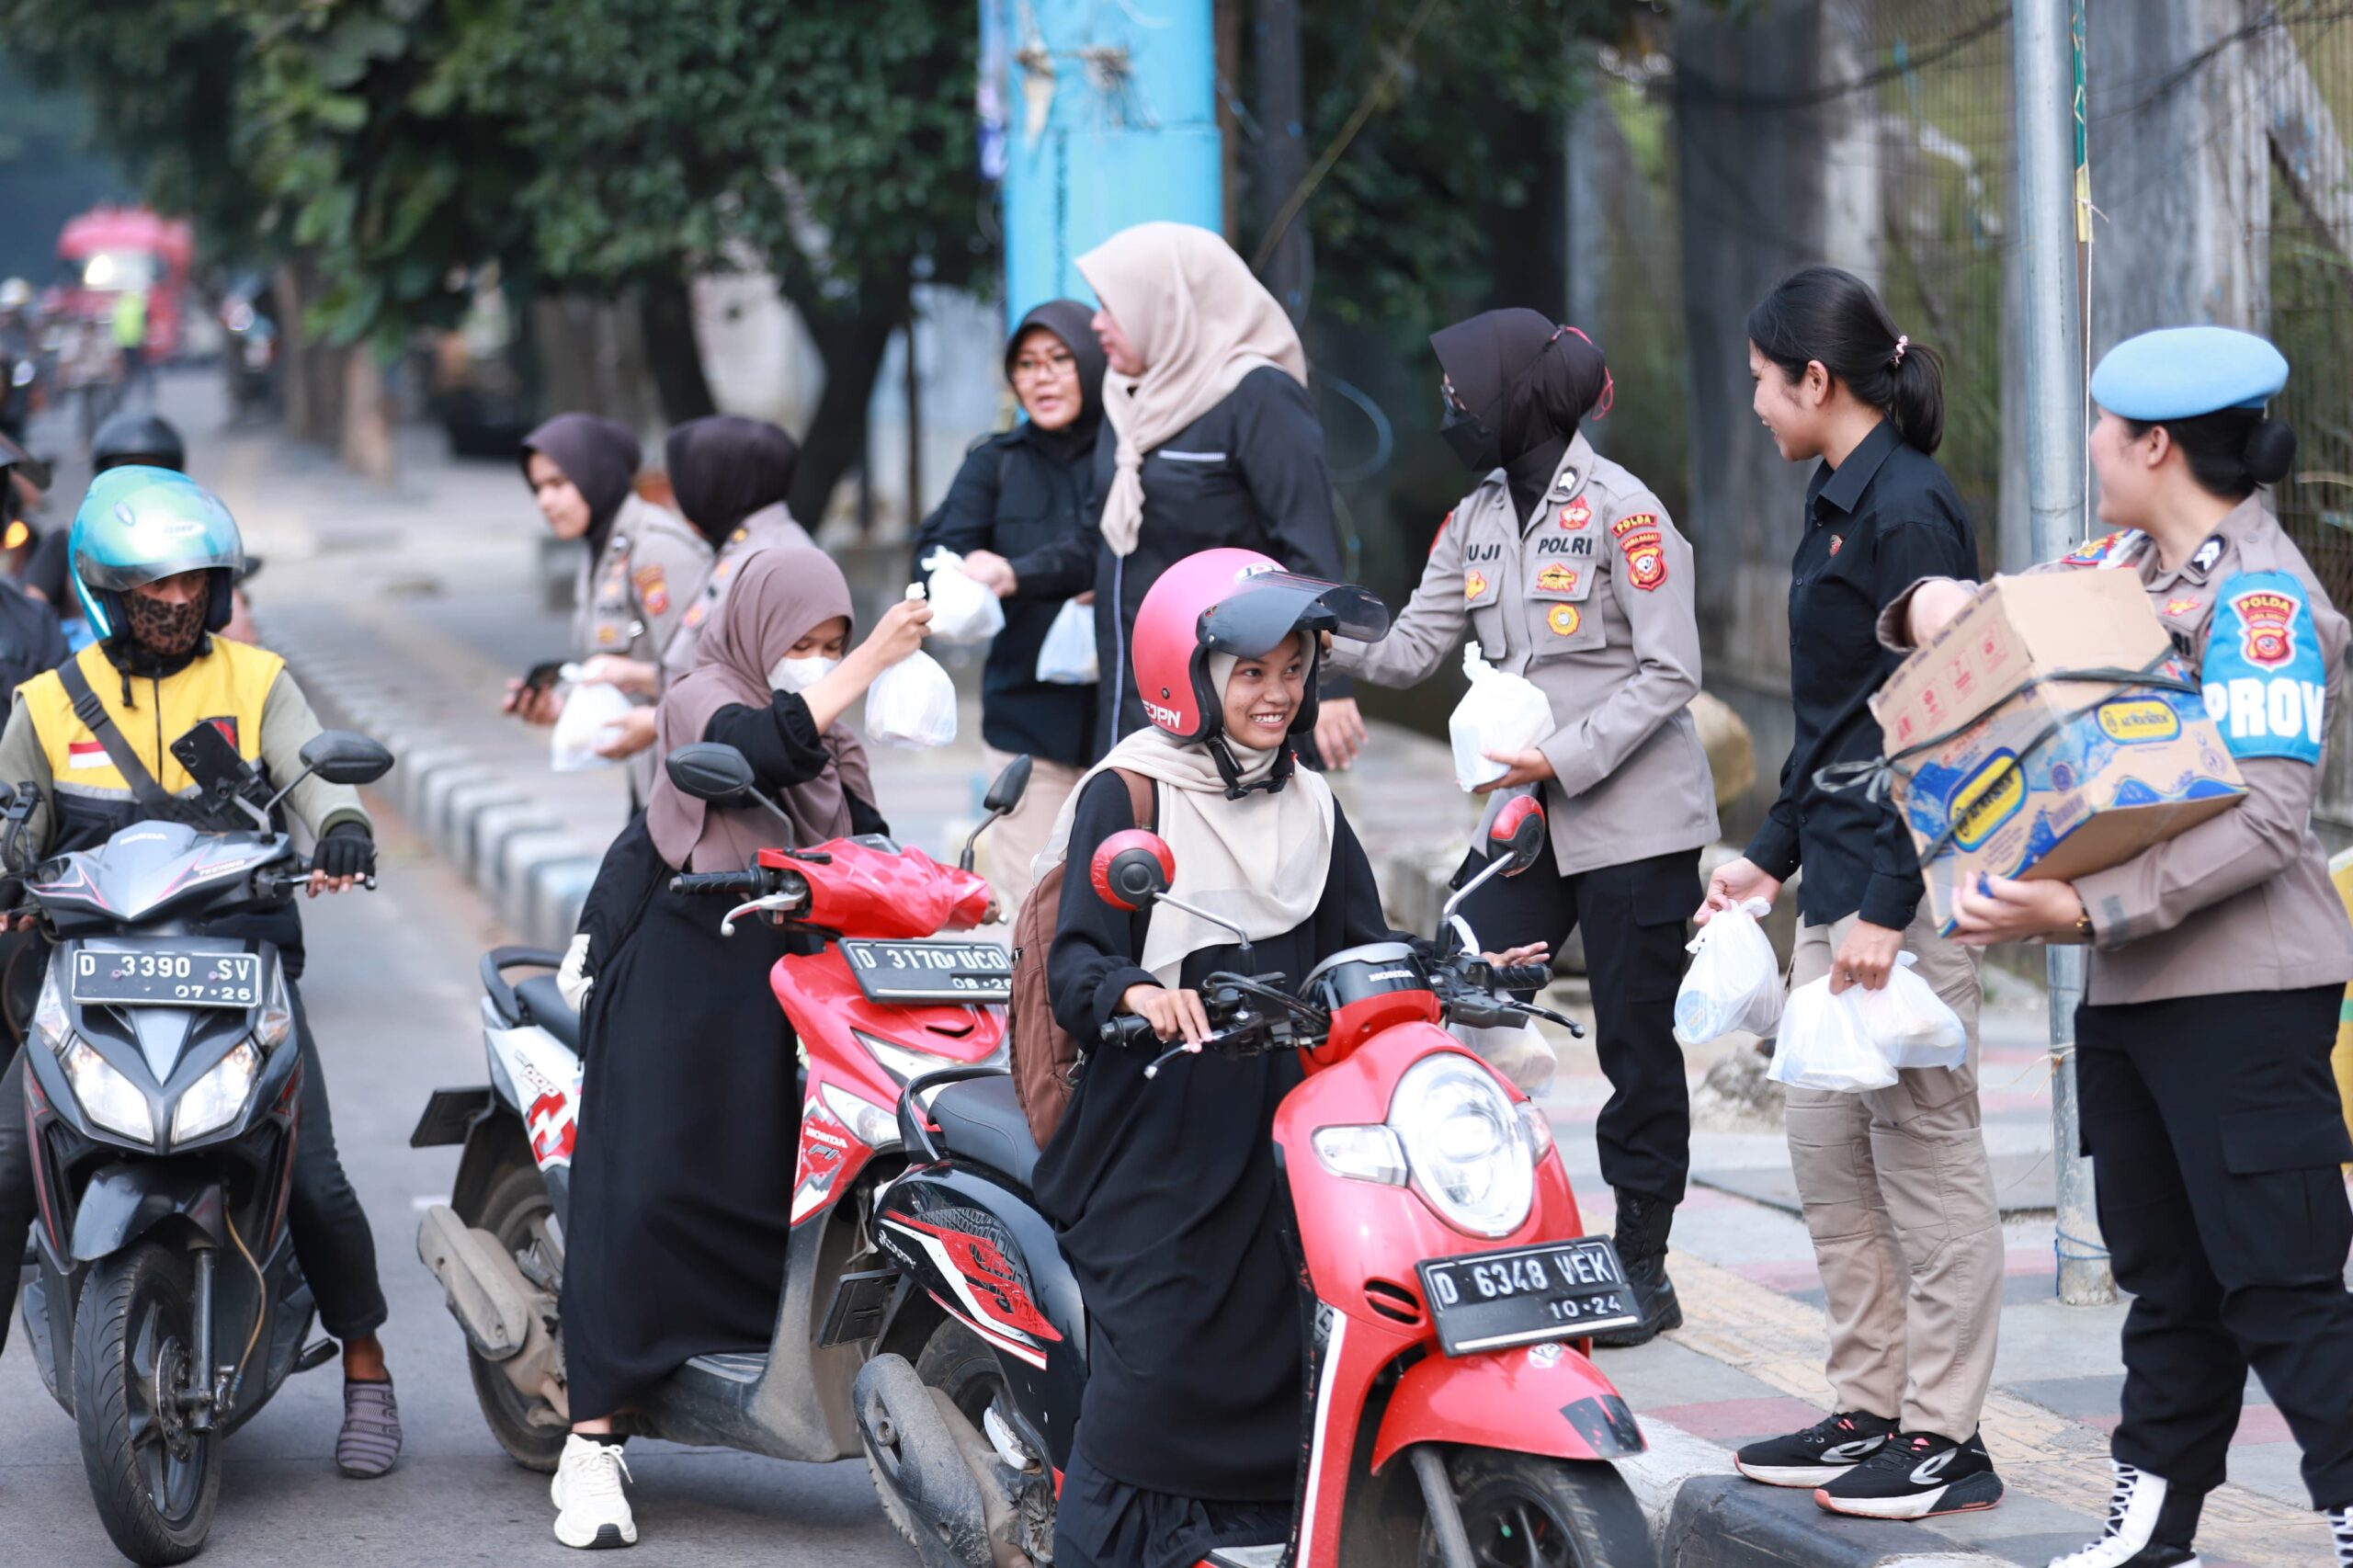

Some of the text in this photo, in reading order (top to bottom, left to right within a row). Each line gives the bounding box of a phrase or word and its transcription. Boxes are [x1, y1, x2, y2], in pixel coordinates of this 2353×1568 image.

[1616, 515, 1652, 533] POLDA
[1465, 544, 1501, 561] UJI
[1538, 537, 1593, 555] POLRI
[2240, 597, 2290, 614] POLDA
[80, 955, 249, 981] D 3390 SV
[856, 949, 877, 968] D
[886, 949, 950, 970] 3170
[1368, 970, 1415, 983] HONDA
[805, 1126, 848, 1148] HONDA
[1433, 1251, 1613, 1305] D 6348 VEK
